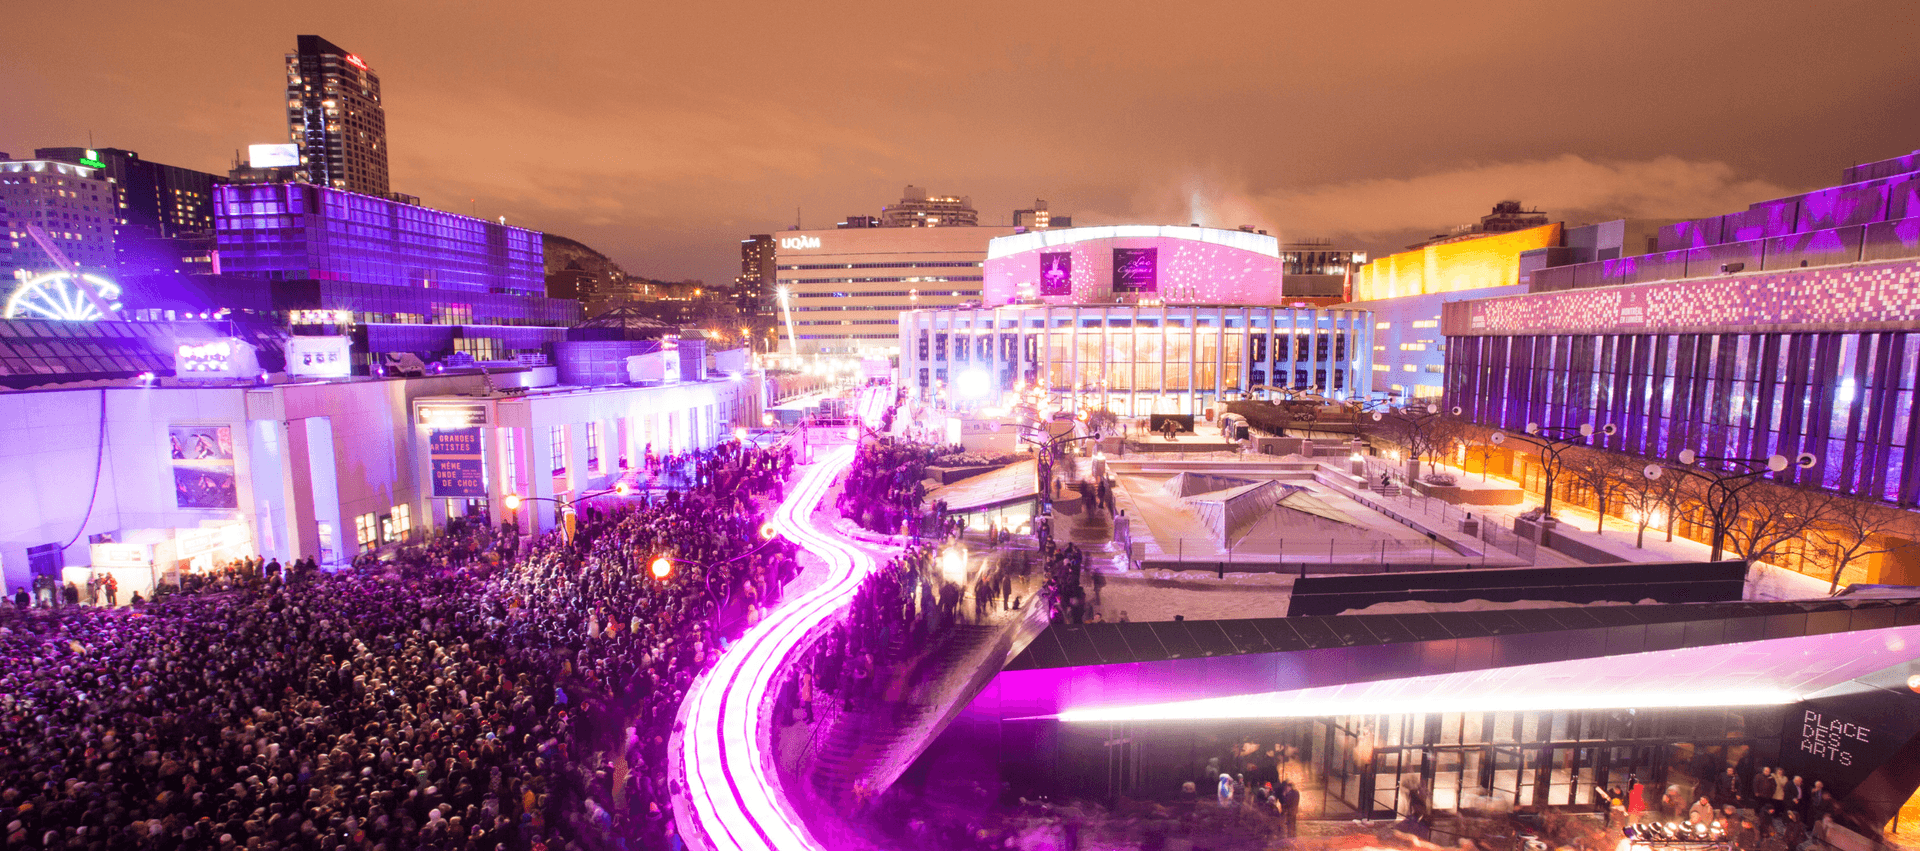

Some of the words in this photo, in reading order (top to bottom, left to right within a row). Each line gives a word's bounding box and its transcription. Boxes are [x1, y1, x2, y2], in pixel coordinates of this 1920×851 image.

[782, 235, 820, 250] UQÀM
[430, 443, 470, 451] ARTISTES
[441, 461, 461, 470] MÊME
[442, 479, 452, 487] DE
[457, 479, 478, 487] CHOC
[1804, 710, 1871, 743] PLACE
[1803, 723, 1841, 748] DES
[1801, 739, 1852, 766] ARTS
